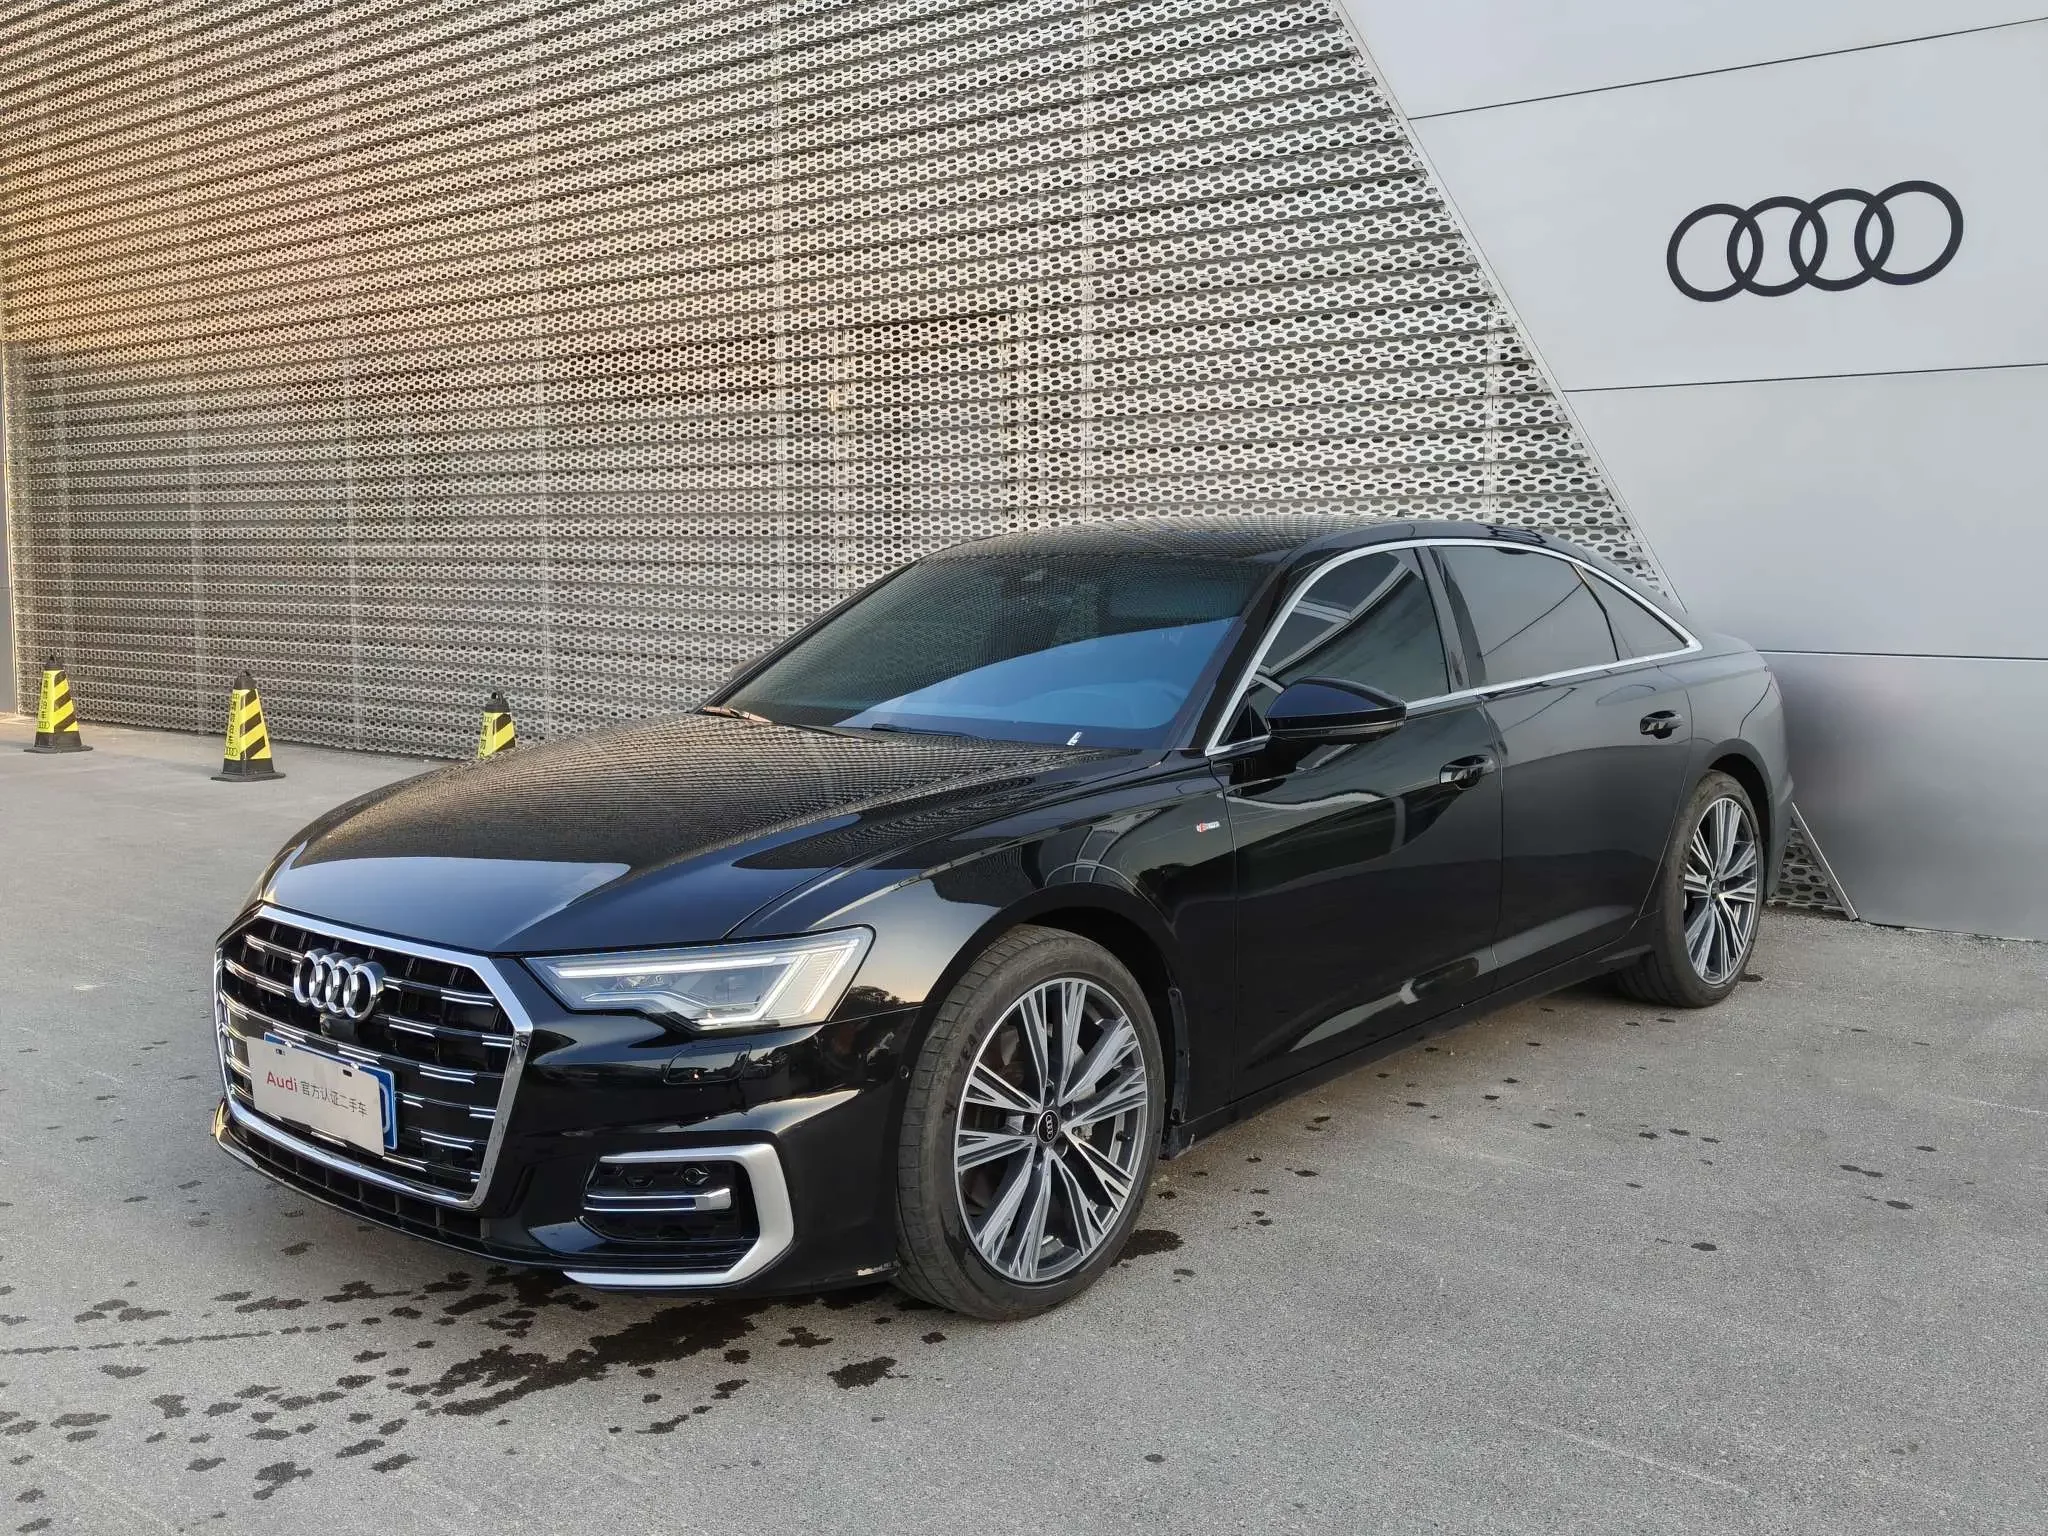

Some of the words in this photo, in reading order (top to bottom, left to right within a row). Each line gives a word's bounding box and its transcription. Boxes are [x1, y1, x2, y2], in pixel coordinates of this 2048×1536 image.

[267, 1071, 298, 1092] Audi
[300, 1081, 368, 1117] 官方认证二手车
